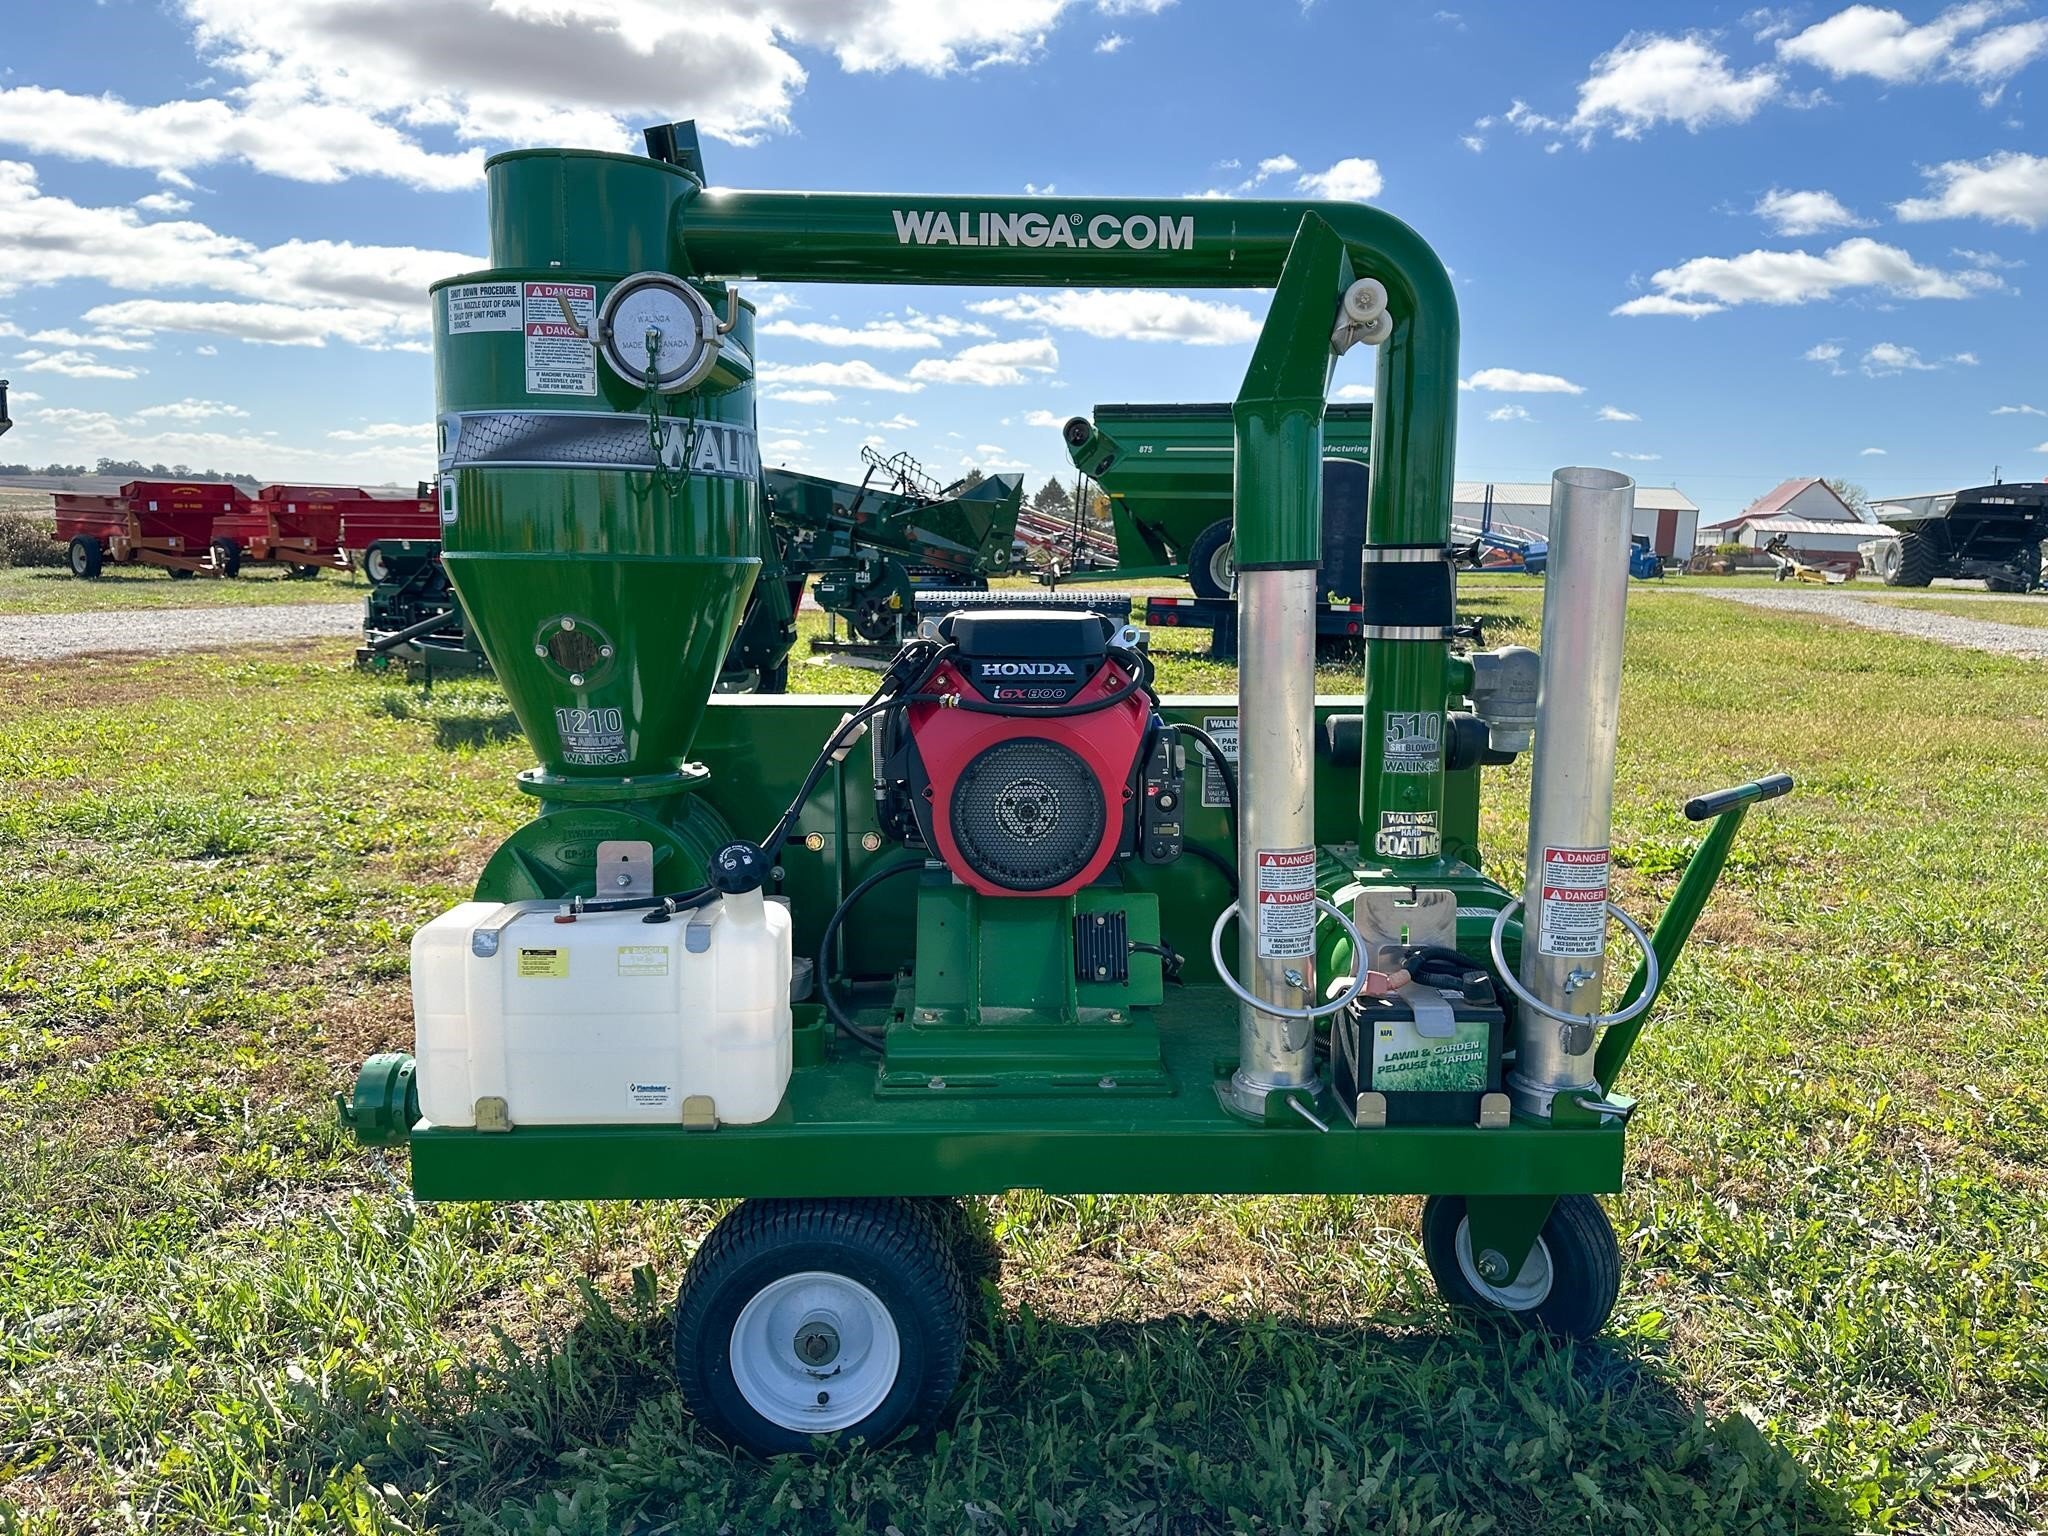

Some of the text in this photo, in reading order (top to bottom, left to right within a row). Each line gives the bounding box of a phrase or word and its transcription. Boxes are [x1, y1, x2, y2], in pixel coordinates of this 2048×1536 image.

[450, 285, 517, 299] SHUT DOWN PROCEDURE
[453, 302, 463, 311] PULL
[464, 300, 481, 310] NOZZLE
[482, 300, 493, 308] OUT
[493, 299, 501, 308] OF
[501, 299, 521, 308] GRAIN
[453, 312, 464, 321] SHUT
[465, 311, 474, 319] OFF
[474, 310, 485, 319] UNIT
[486, 310, 507, 318] POWER
[623, 341, 643, 349] MADE
[981, 663, 1075, 676] HONDA
[993, 685, 1067, 699] iGX800
[556, 708, 623, 734] 1210
[1385, 712, 1440, 744] 510
[563, 751, 629, 764] WALINGA
[1384, 759, 1440, 772] WALINGA
[1387, 813, 1434, 824] WALINGA
[1400, 828, 1422, 837] HARD
[1375, 831, 1440, 856] COATING
[1279, 854, 1314, 866] DANGER
[1567, 853, 1607, 863] DANGER
[1279, 891, 1314, 903] DANGER
[1564, 890, 1604, 901] DANGER
[1380, 1029, 1393, 1037] NAPA
[1384, 1040, 1480, 1062] LAWN & GARDEN
[1376, 1051, 1483, 1074] PELOUSE et JARDIN
